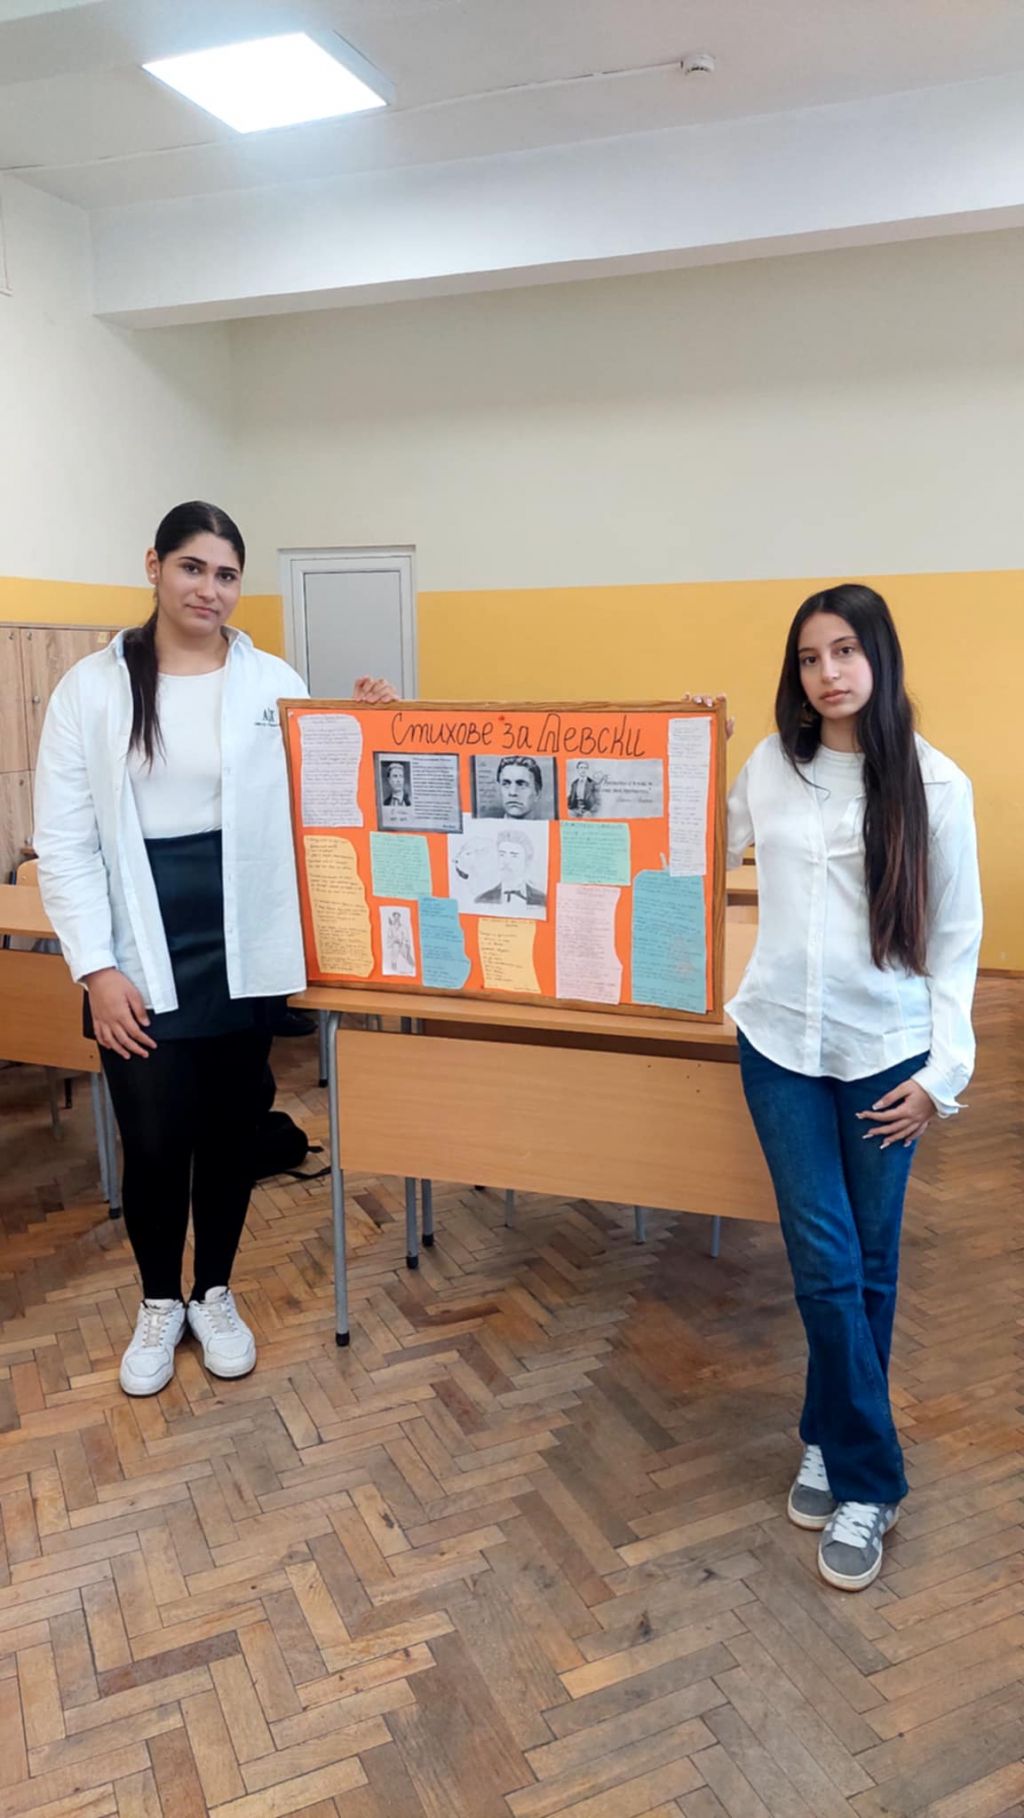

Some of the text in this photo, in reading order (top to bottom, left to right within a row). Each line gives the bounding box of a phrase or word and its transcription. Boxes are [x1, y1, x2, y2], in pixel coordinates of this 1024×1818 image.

[391, 712, 645, 757] Стихове за Левски
